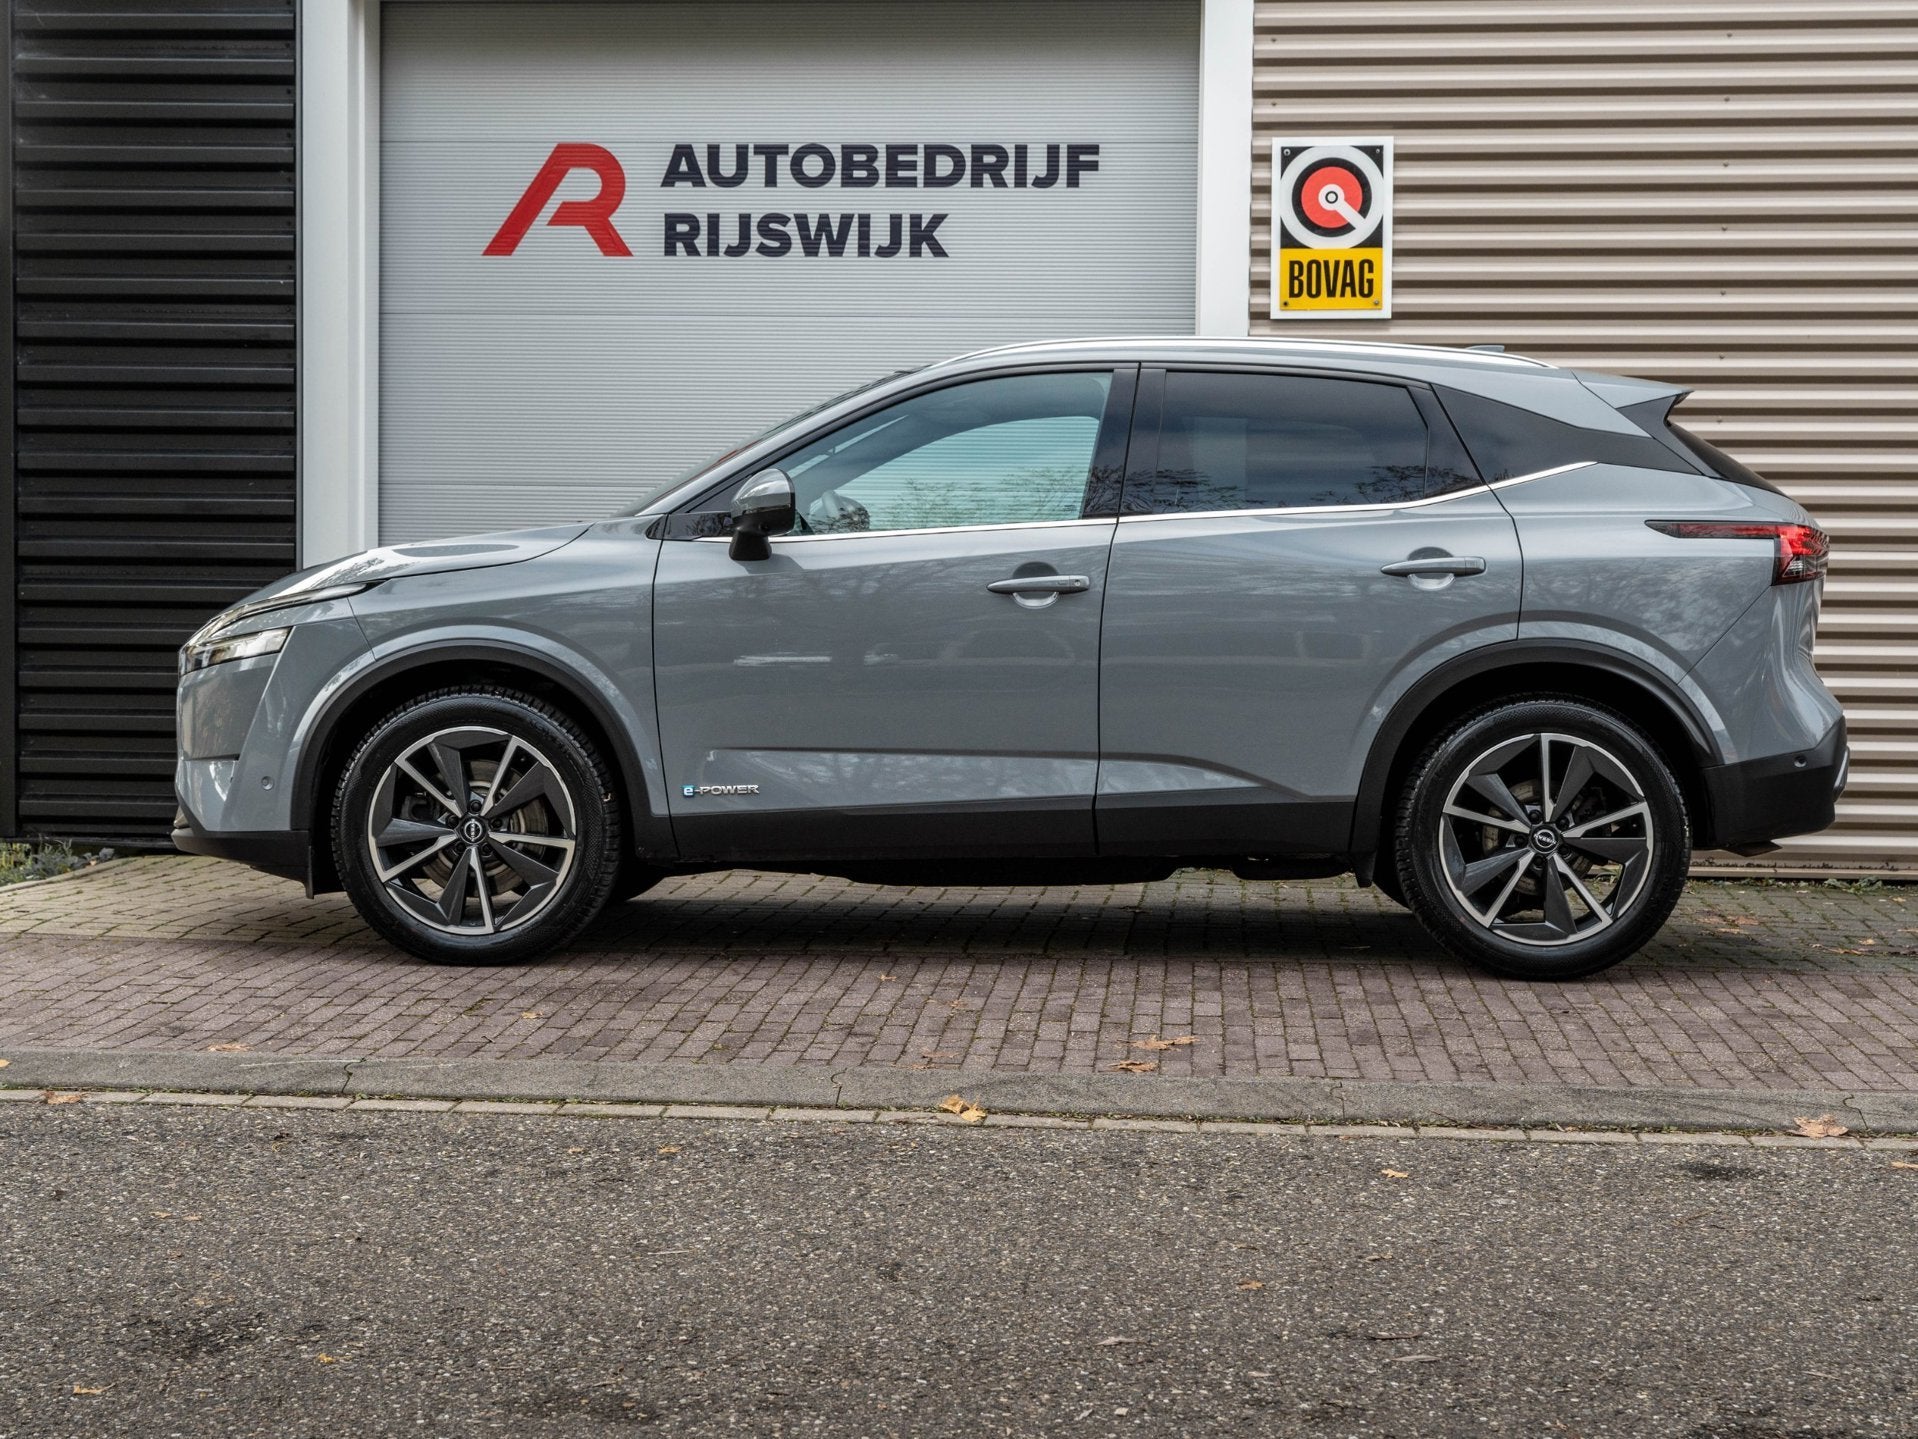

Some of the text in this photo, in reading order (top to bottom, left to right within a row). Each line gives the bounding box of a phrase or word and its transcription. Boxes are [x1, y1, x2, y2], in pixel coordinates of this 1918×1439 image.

[660, 144, 1101, 188] AUTOBEDRIJF
[664, 212, 950, 258] RIJSWIJK
[1288, 258, 1375, 299] BOVAG
[682, 784, 760, 797] e-POWER
